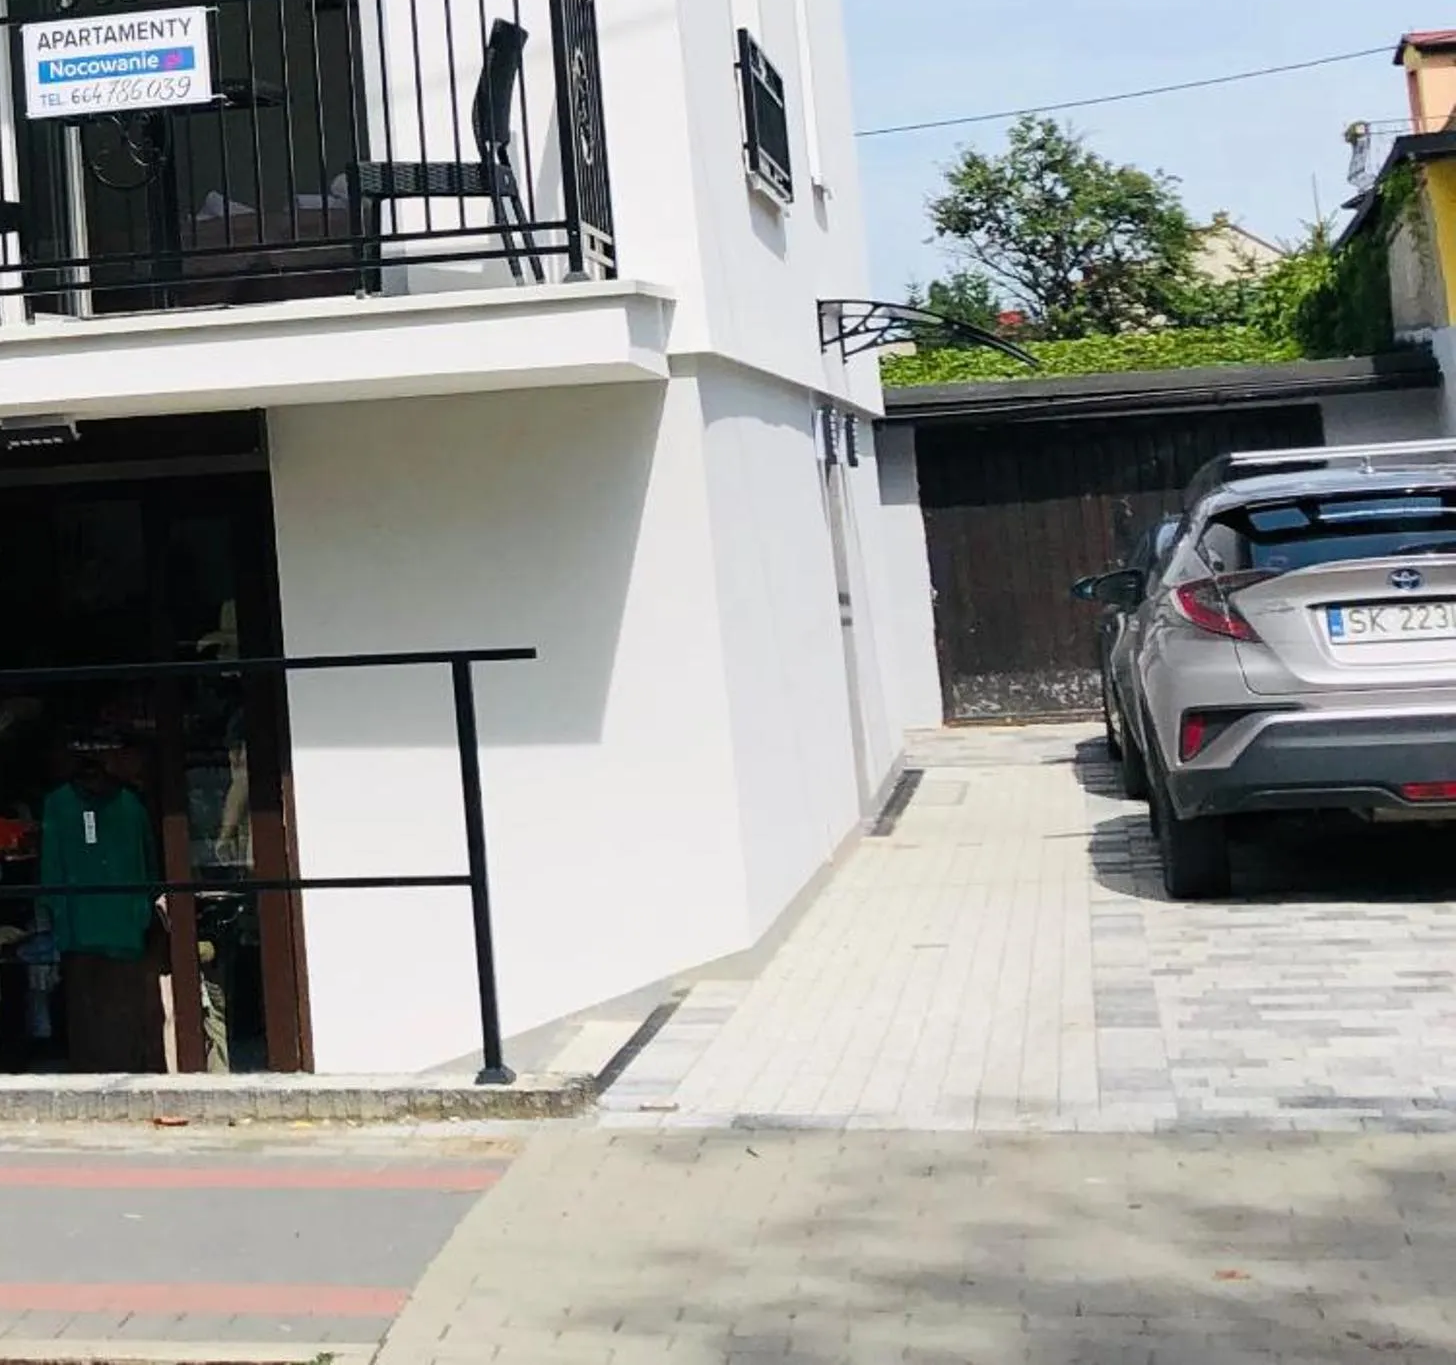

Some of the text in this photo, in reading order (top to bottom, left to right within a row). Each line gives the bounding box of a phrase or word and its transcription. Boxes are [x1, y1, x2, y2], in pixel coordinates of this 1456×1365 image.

[37, 17, 193, 51] APARTAMENTY
[1348, 603, 1456, 634] SK 223
